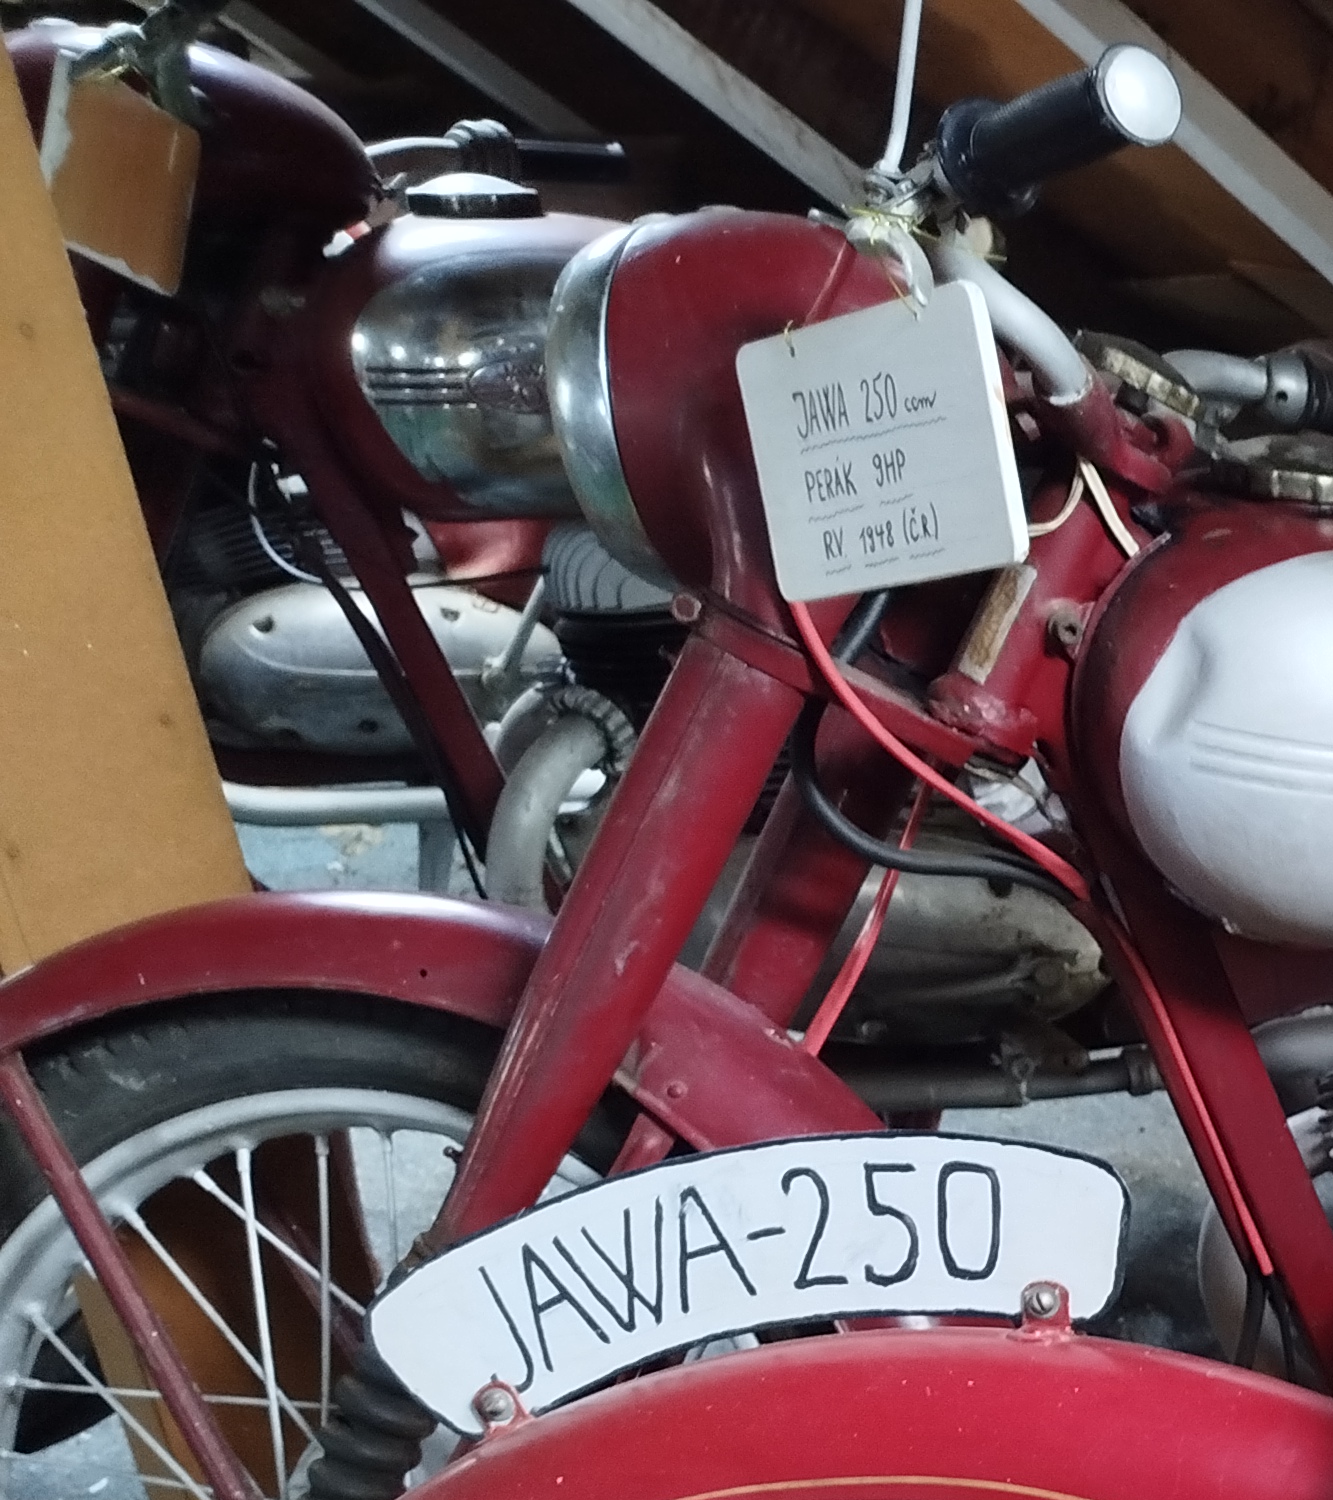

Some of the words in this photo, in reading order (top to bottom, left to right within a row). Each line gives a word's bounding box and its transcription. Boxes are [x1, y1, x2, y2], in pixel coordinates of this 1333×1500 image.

[792, 382, 850, 439] JAWA
[860, 372, 897, 424] 250
[904, 391, 937, 413] ccm
[804, 456, 858, 503] PERÁK
[872, 448, 906, 487] 9HP
[859, 520, 895, 555] 1948
[478, 1161, 1001, 1395] JAWA-250
